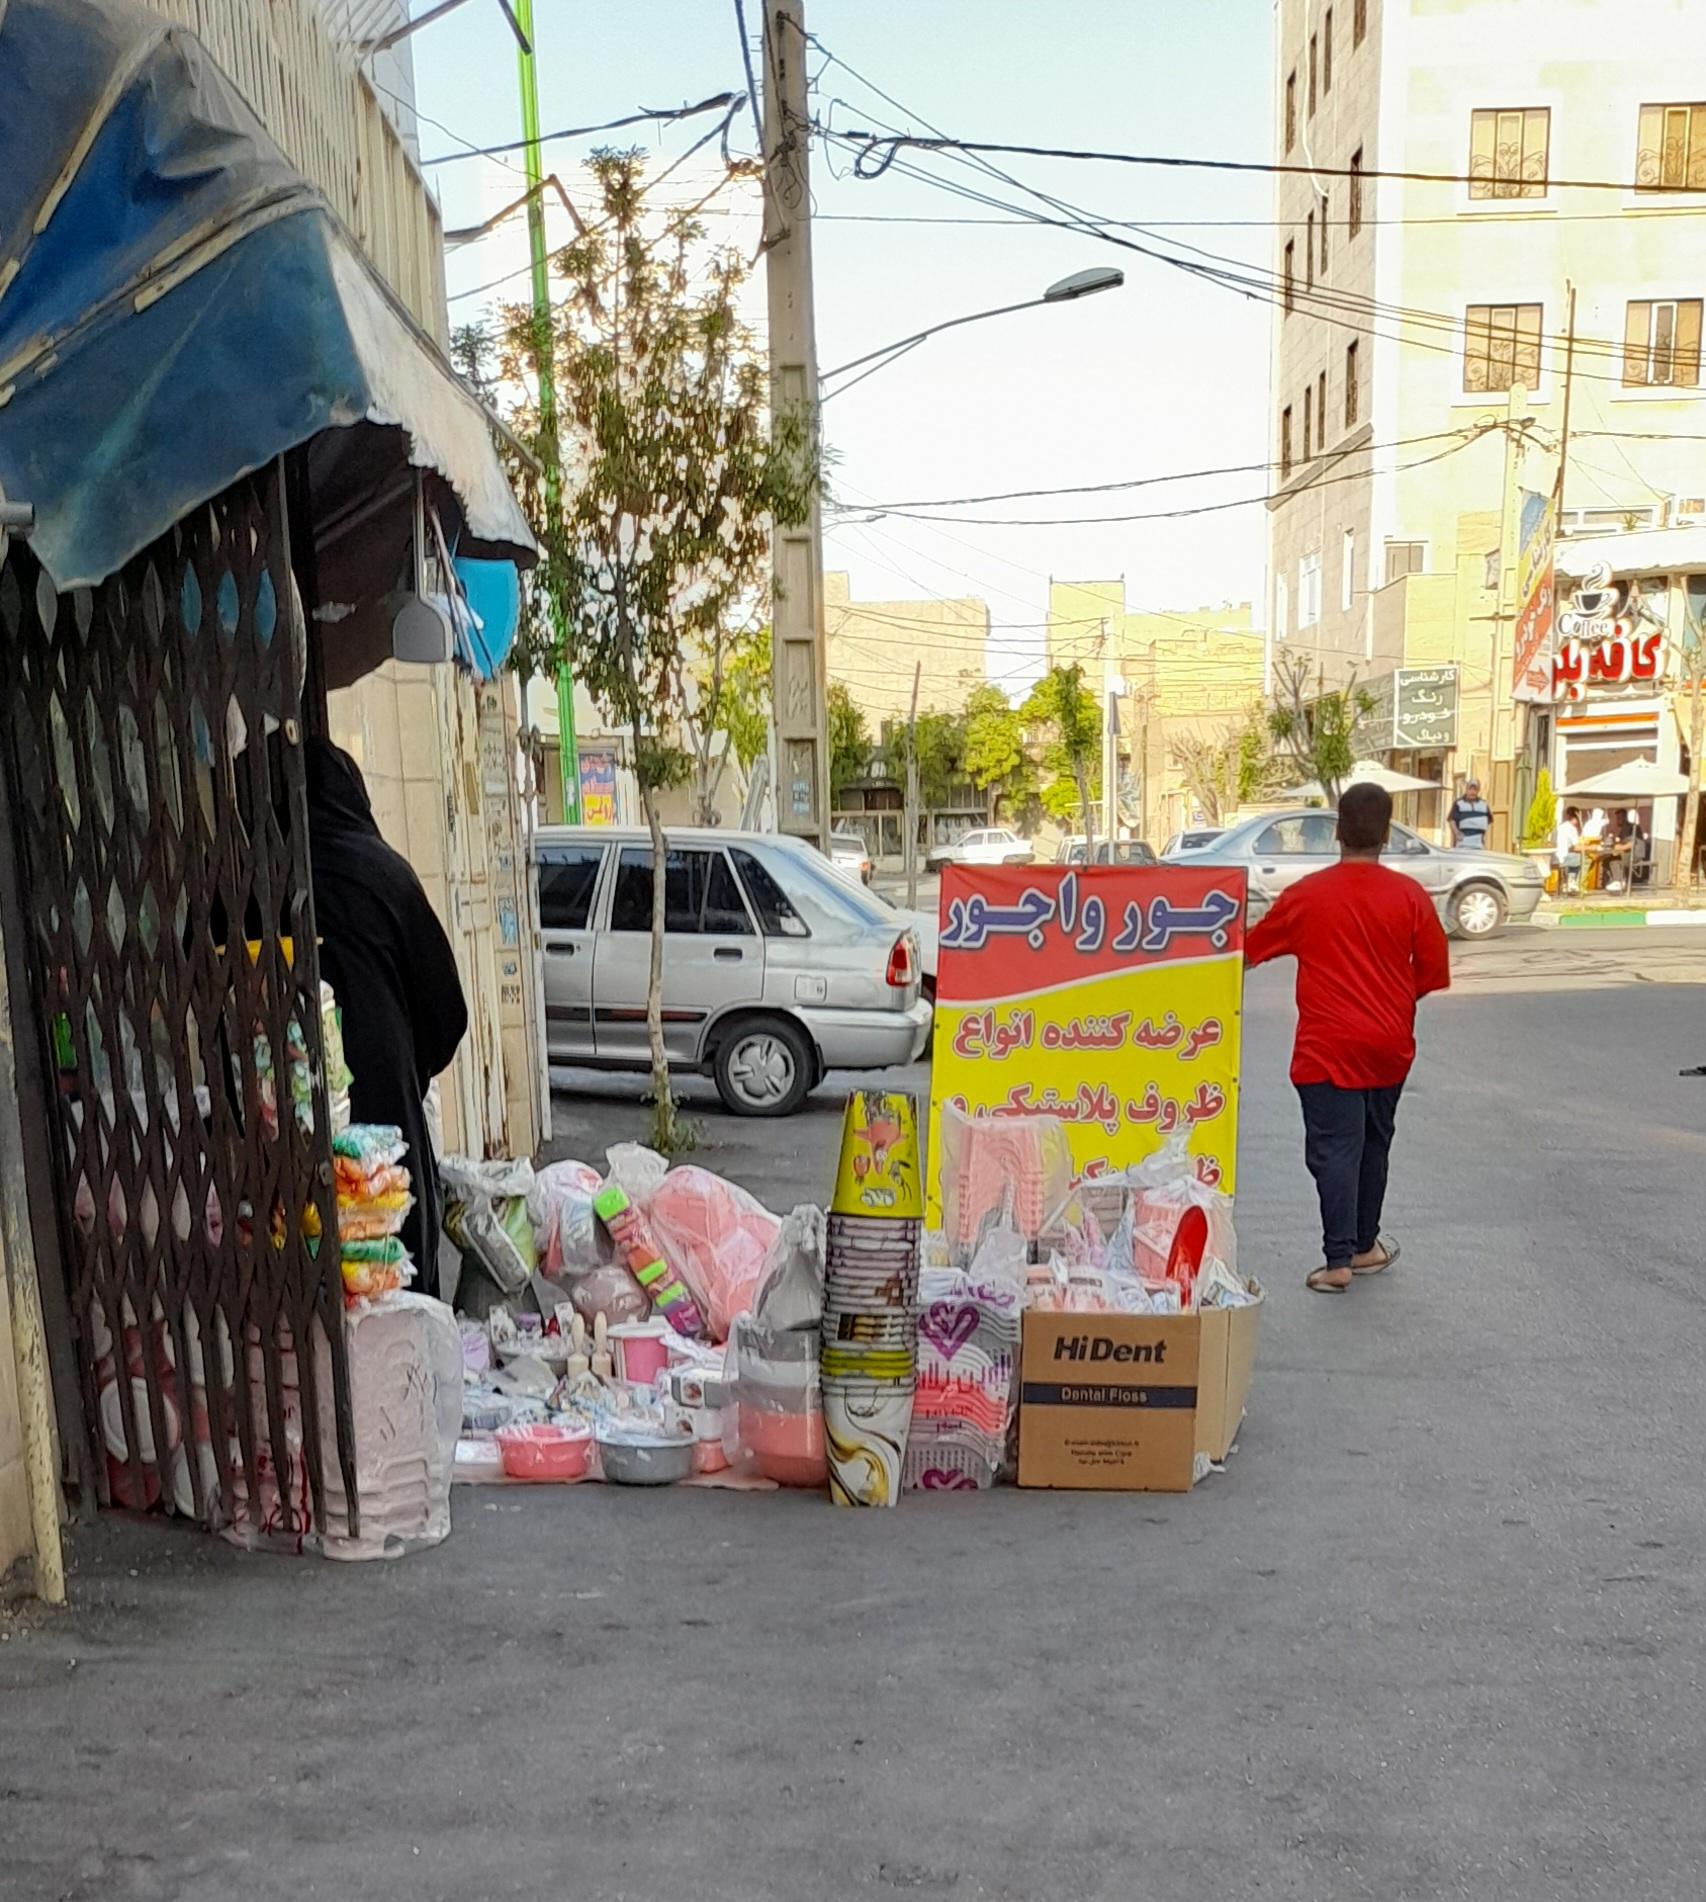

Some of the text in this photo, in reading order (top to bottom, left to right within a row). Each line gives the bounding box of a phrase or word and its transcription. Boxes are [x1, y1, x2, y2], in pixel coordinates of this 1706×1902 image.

[1557, 613, 1608, 637] Coffee
[1589, 622, 1664, 682] کافه
[1400, 669, 1455, 686] کارشناسی
[1402, 708, 1452, 725] خودرو
[1112, 889, 1240, 951] جور
[953, 1008, 1223, 1062] عرضه کننده انواع
[1126, 1082, 1227, 1134] ظروف
[1053, 1335, 1168, 1364] HiDent
[1060, 1386, 1148, 1403] Dental Floss
